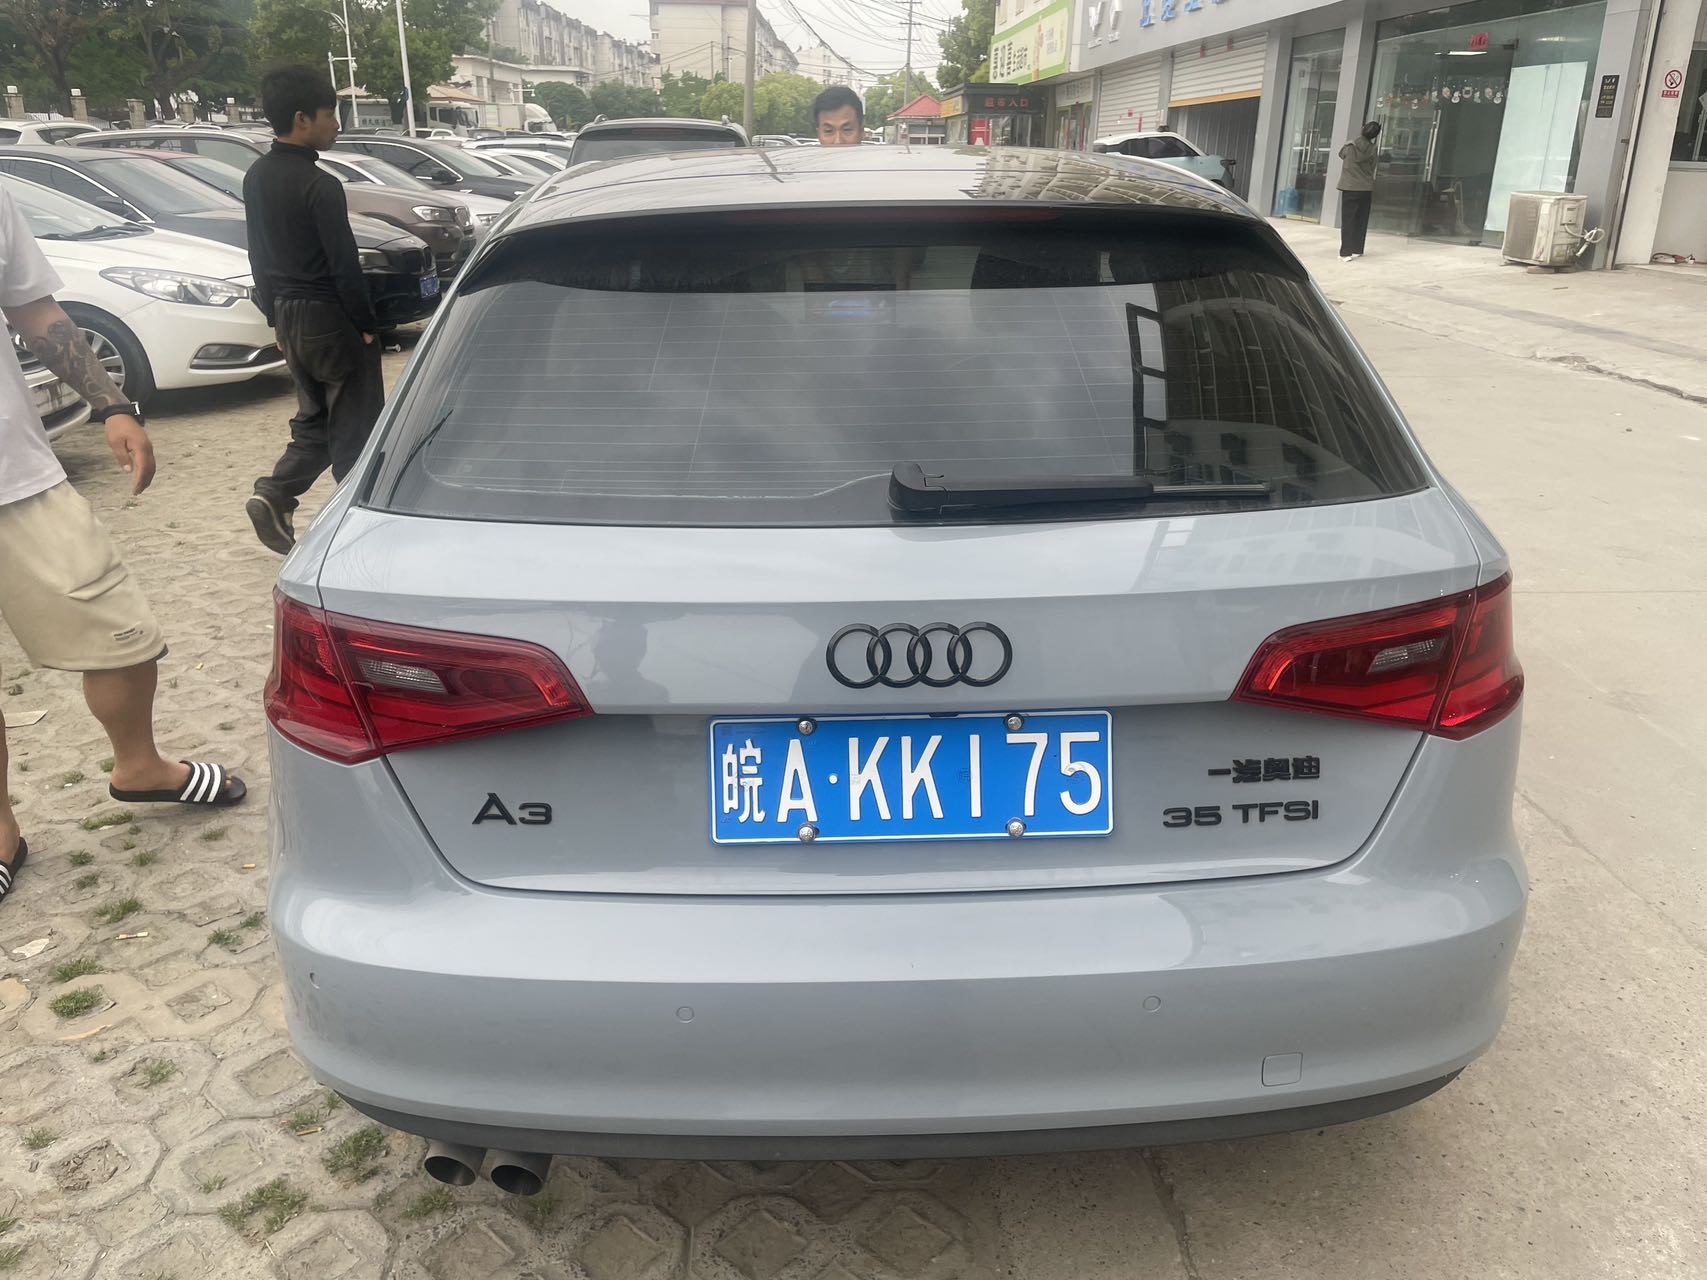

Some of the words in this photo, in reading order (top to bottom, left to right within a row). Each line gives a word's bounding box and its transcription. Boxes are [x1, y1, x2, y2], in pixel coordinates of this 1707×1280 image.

[722, 731, 1102, 824] 皖A·KK175
[472, 792, 552, 825] A3
[1162, 806, 1222, 828] 35
[1232, 800, 1319, 824] TFSI
